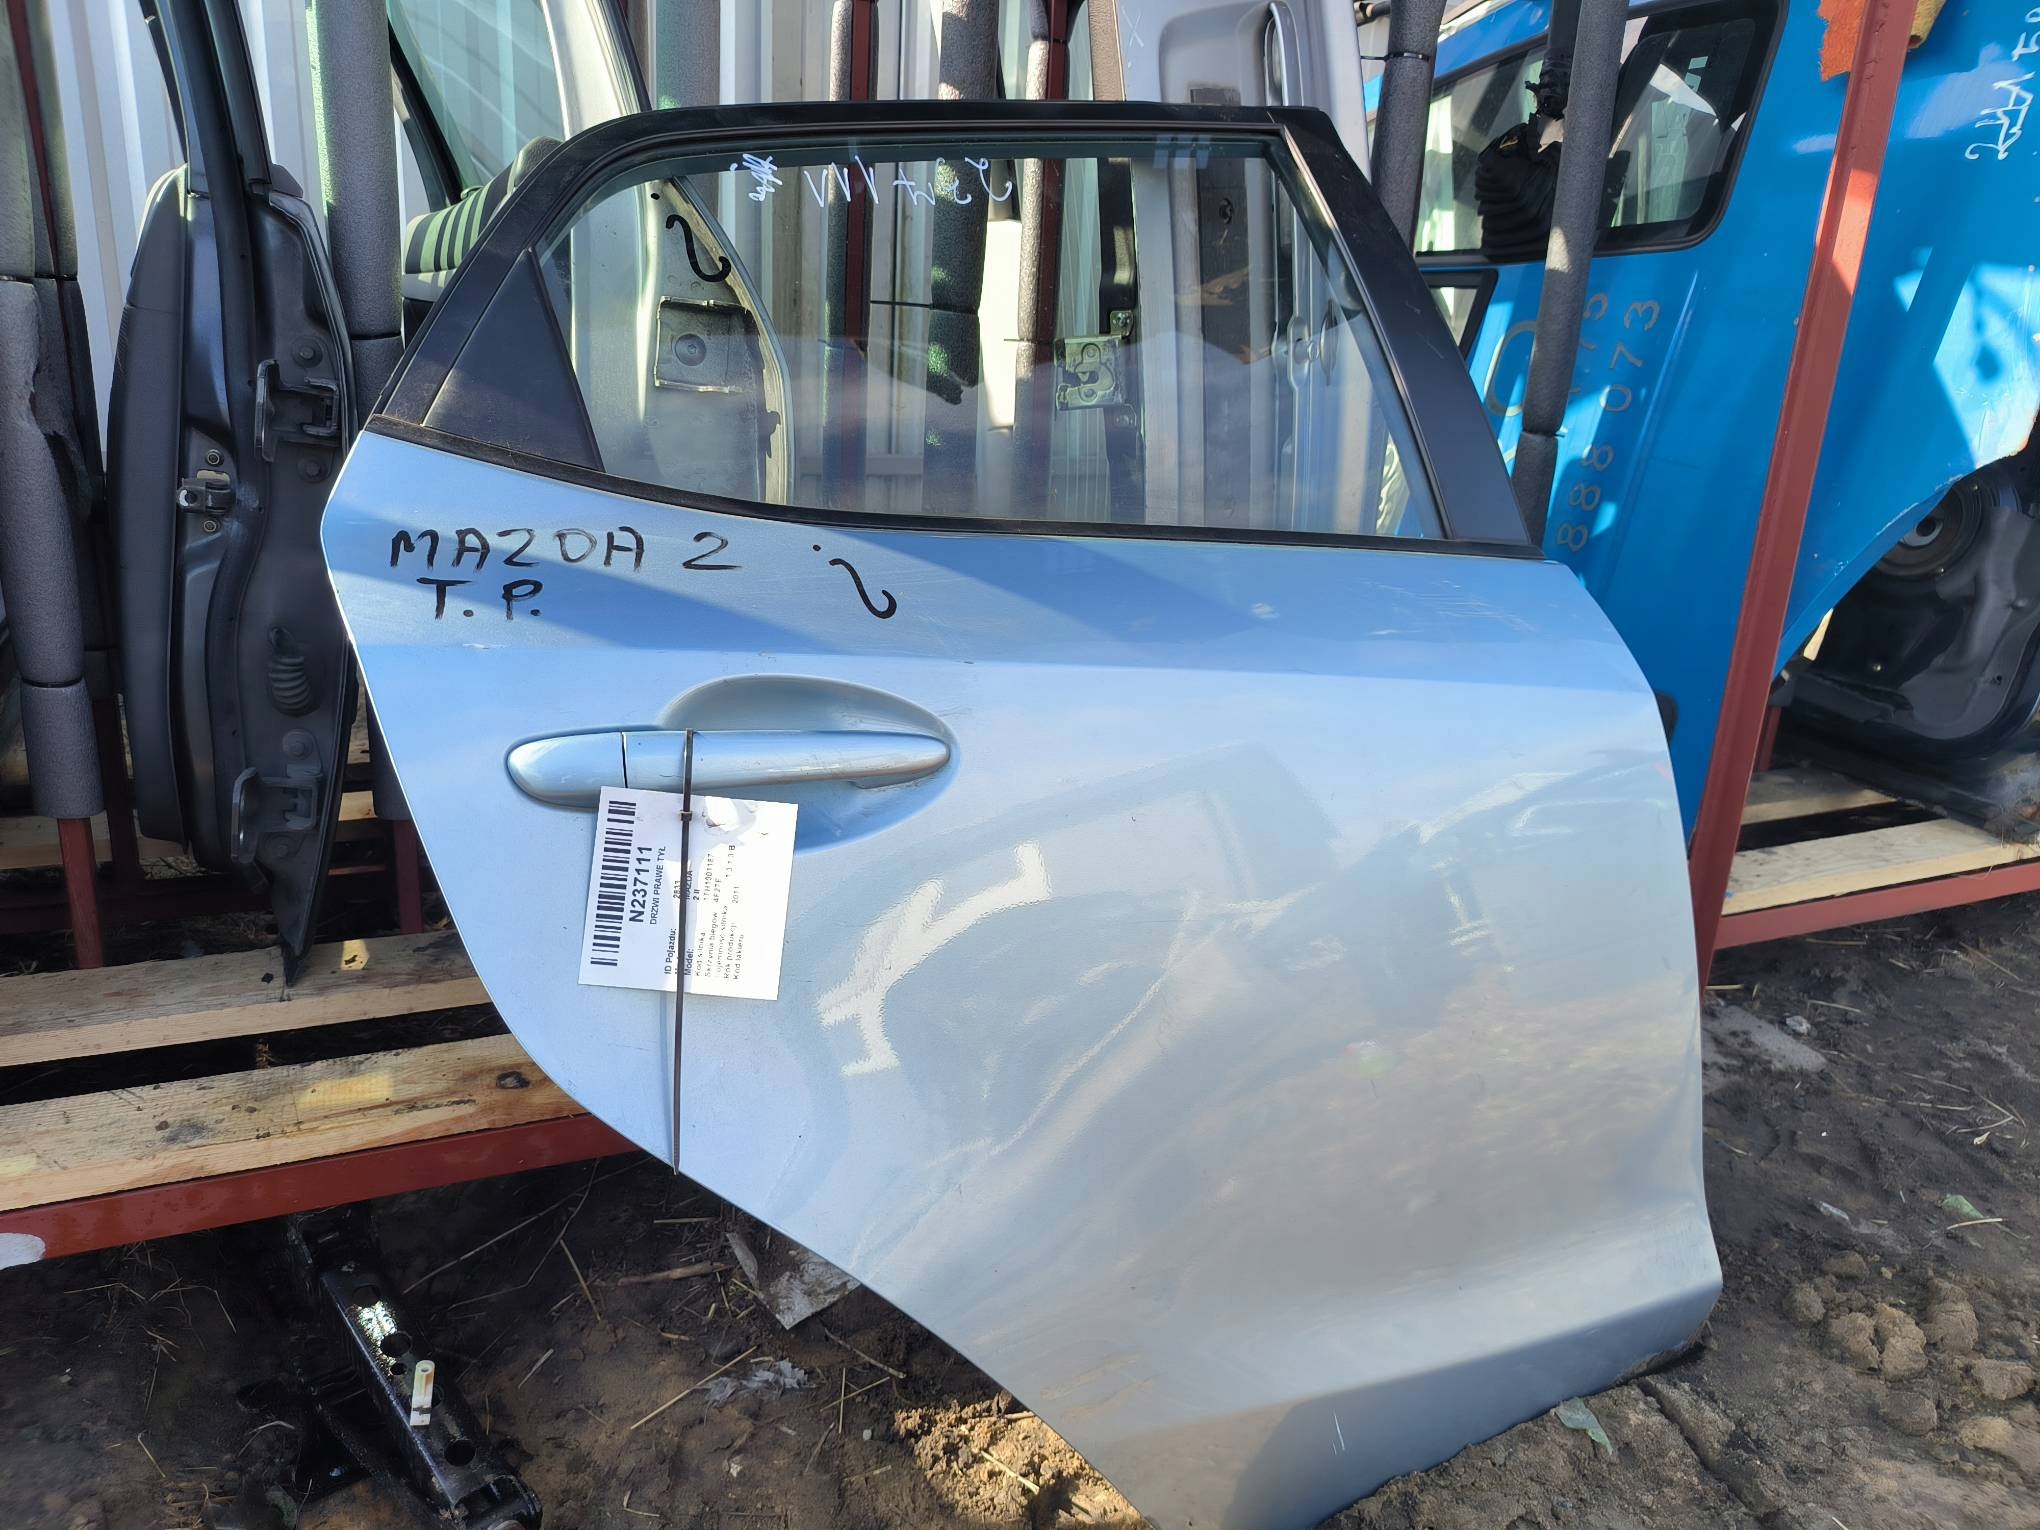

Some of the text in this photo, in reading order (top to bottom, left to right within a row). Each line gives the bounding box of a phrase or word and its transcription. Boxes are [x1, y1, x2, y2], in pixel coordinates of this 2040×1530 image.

[1557, 444, 1616, 551] 888
[1600, 300, 1660, 412] 073
[390, 526, 743, 573] MAZDA 2
[628, 846, 652, 923] N237111
[650, 846, 666, 925] DRZWI PRAWE TYŁ
[665, 928, 678, 963] Pojazdu:
[684, 948, 694, 976] Model:
[664, 965, 672, 975] ID
